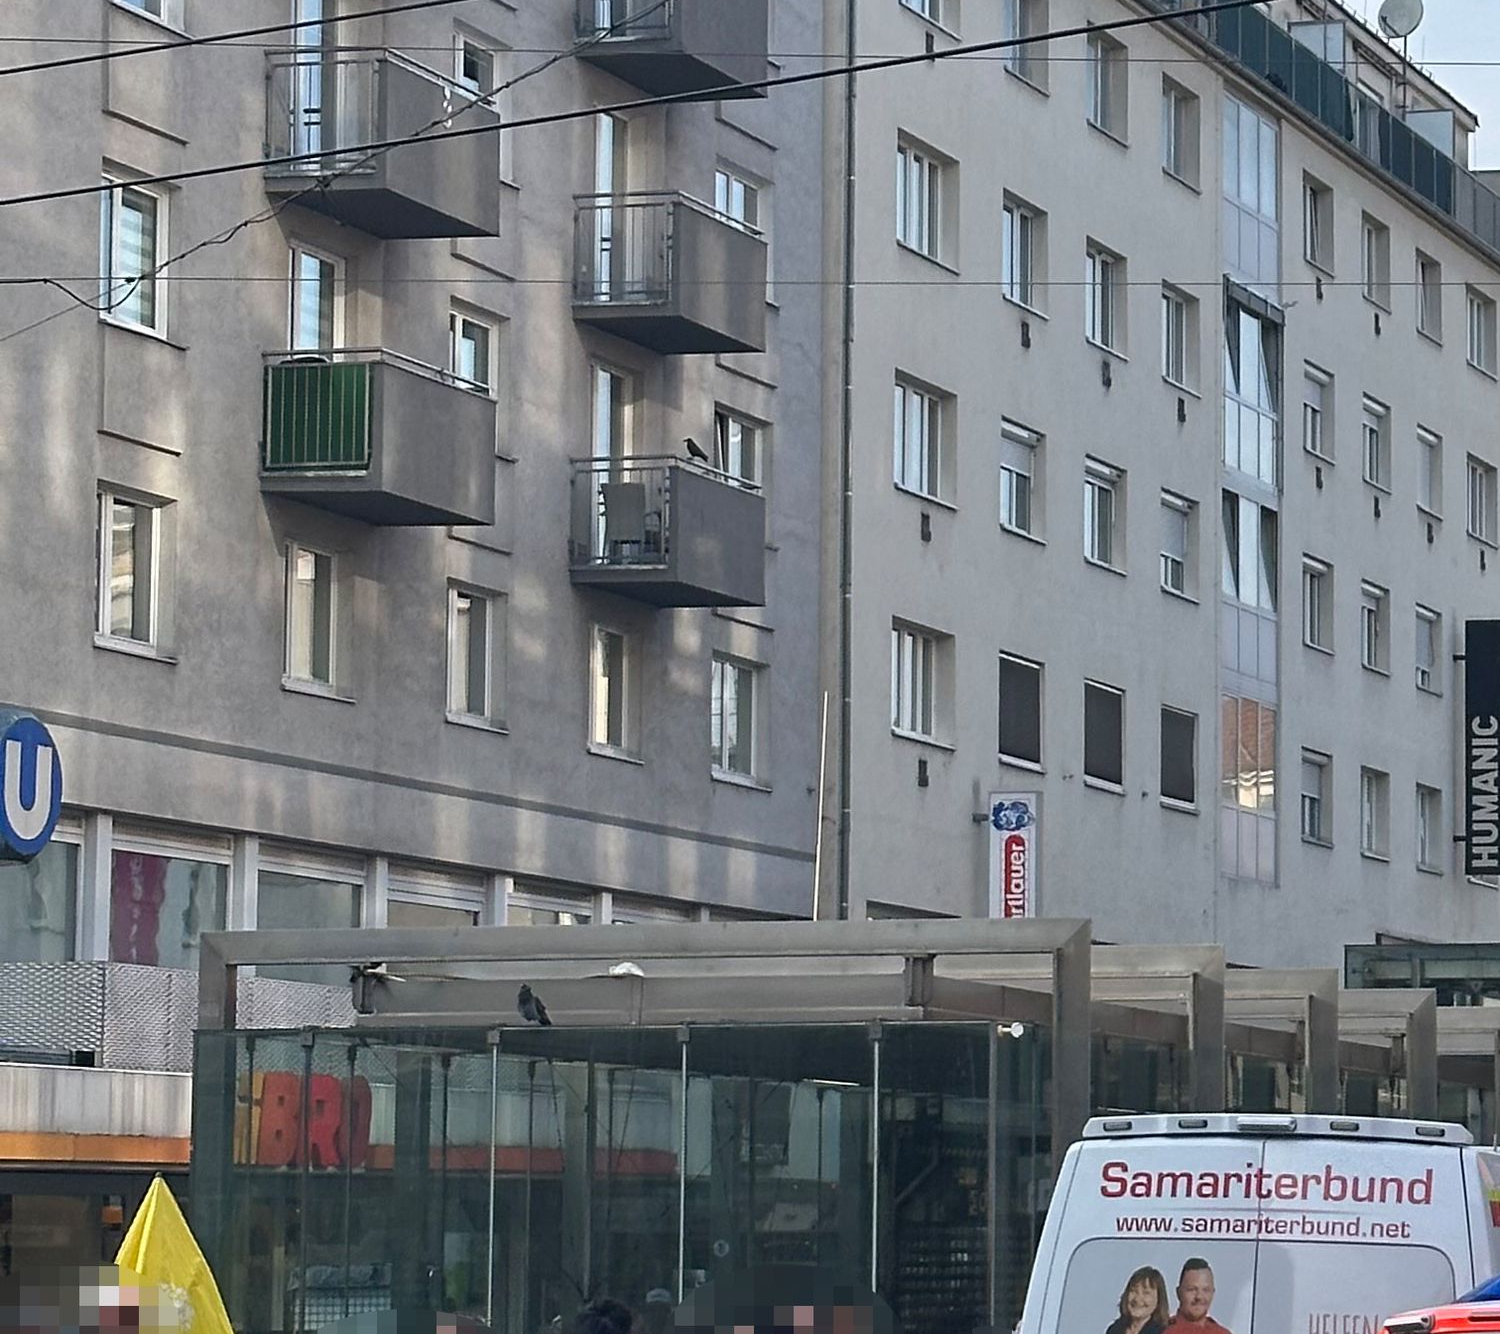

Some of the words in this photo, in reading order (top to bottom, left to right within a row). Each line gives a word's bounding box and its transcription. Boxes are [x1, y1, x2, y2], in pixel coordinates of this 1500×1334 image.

[4, 738, 53, 840] U
[1471, 715, 1499, 868] HUMANIC
[1100, 1161, 1434, 1205] Samariterbund
[1115, 1215, 1412, 1239] www.samariterbund.net
